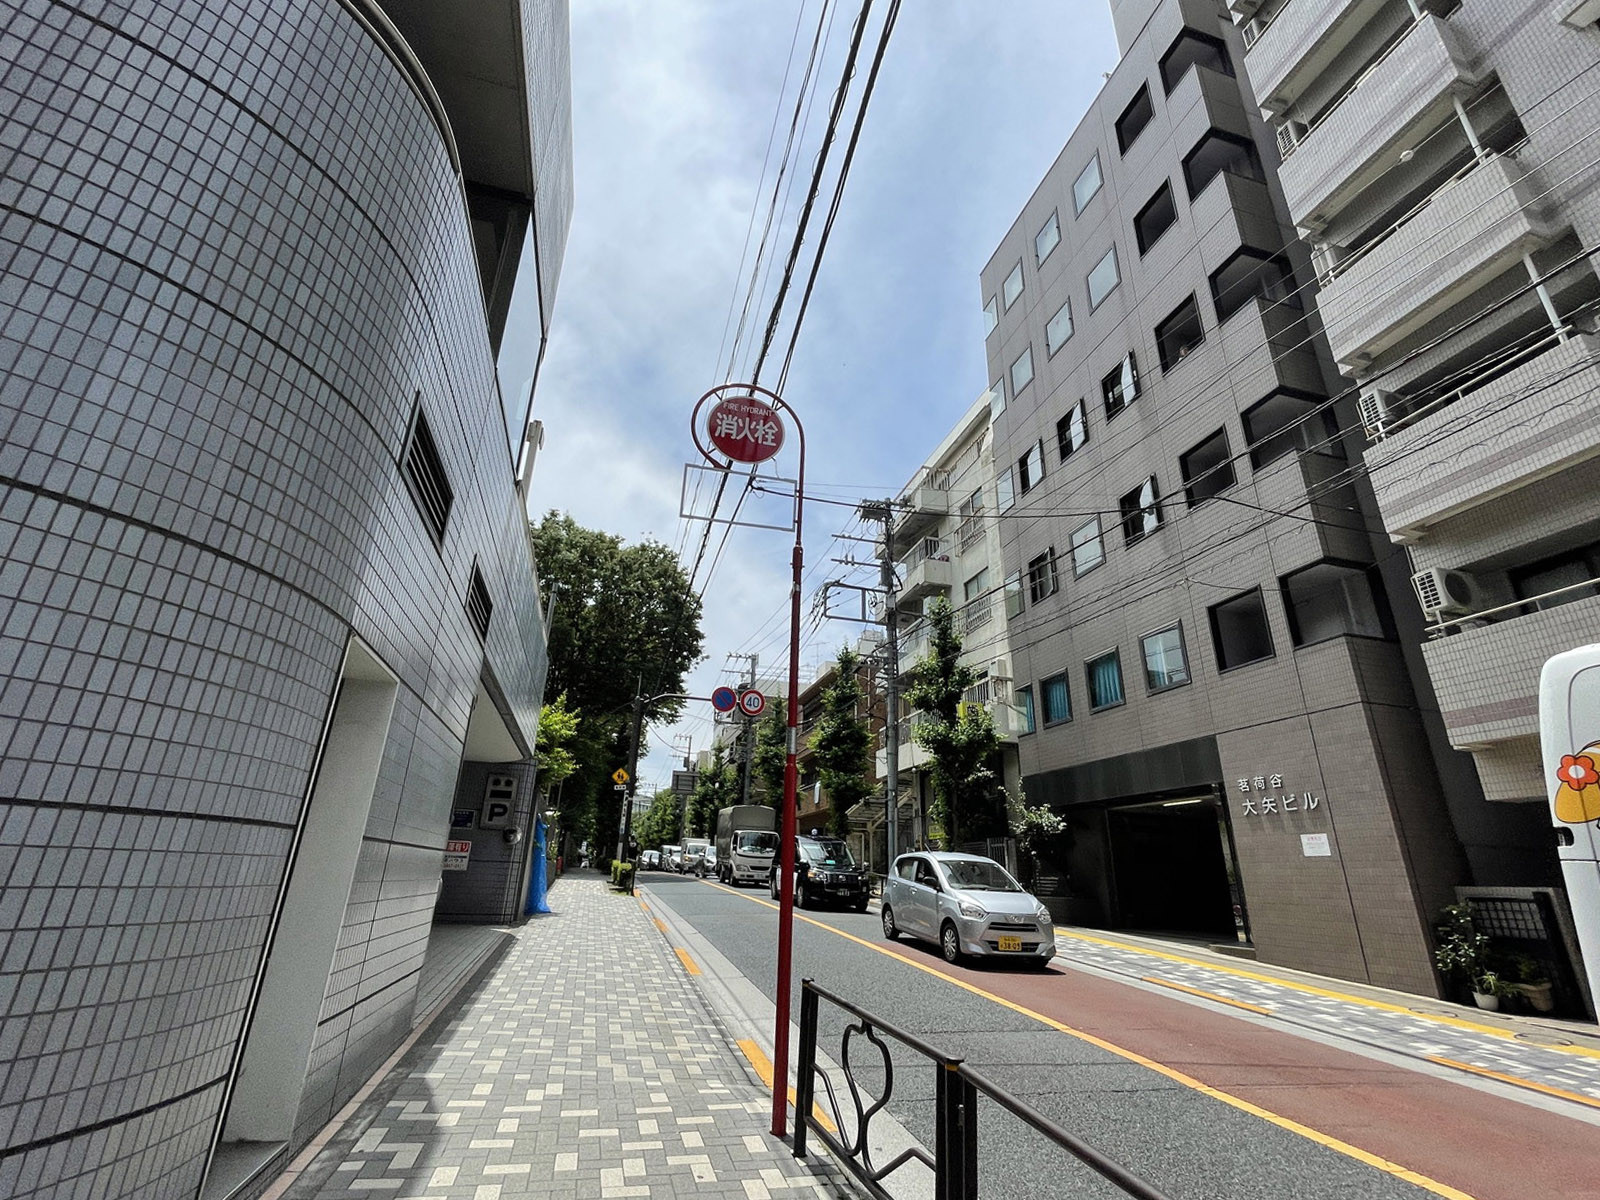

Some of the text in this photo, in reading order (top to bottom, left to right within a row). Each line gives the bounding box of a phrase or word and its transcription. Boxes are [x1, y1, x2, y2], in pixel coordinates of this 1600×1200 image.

[723, 402, 773, 417] FIRE HYDRANT
[715, 413, 778, 447] 消火栓
[746, 696, 760, 708] 40
[1237, 773, 1282, 792] 茗荷谷
[488, 803, 508, 822] P
[1242, 792, 1319, 816] 大矢ビル
